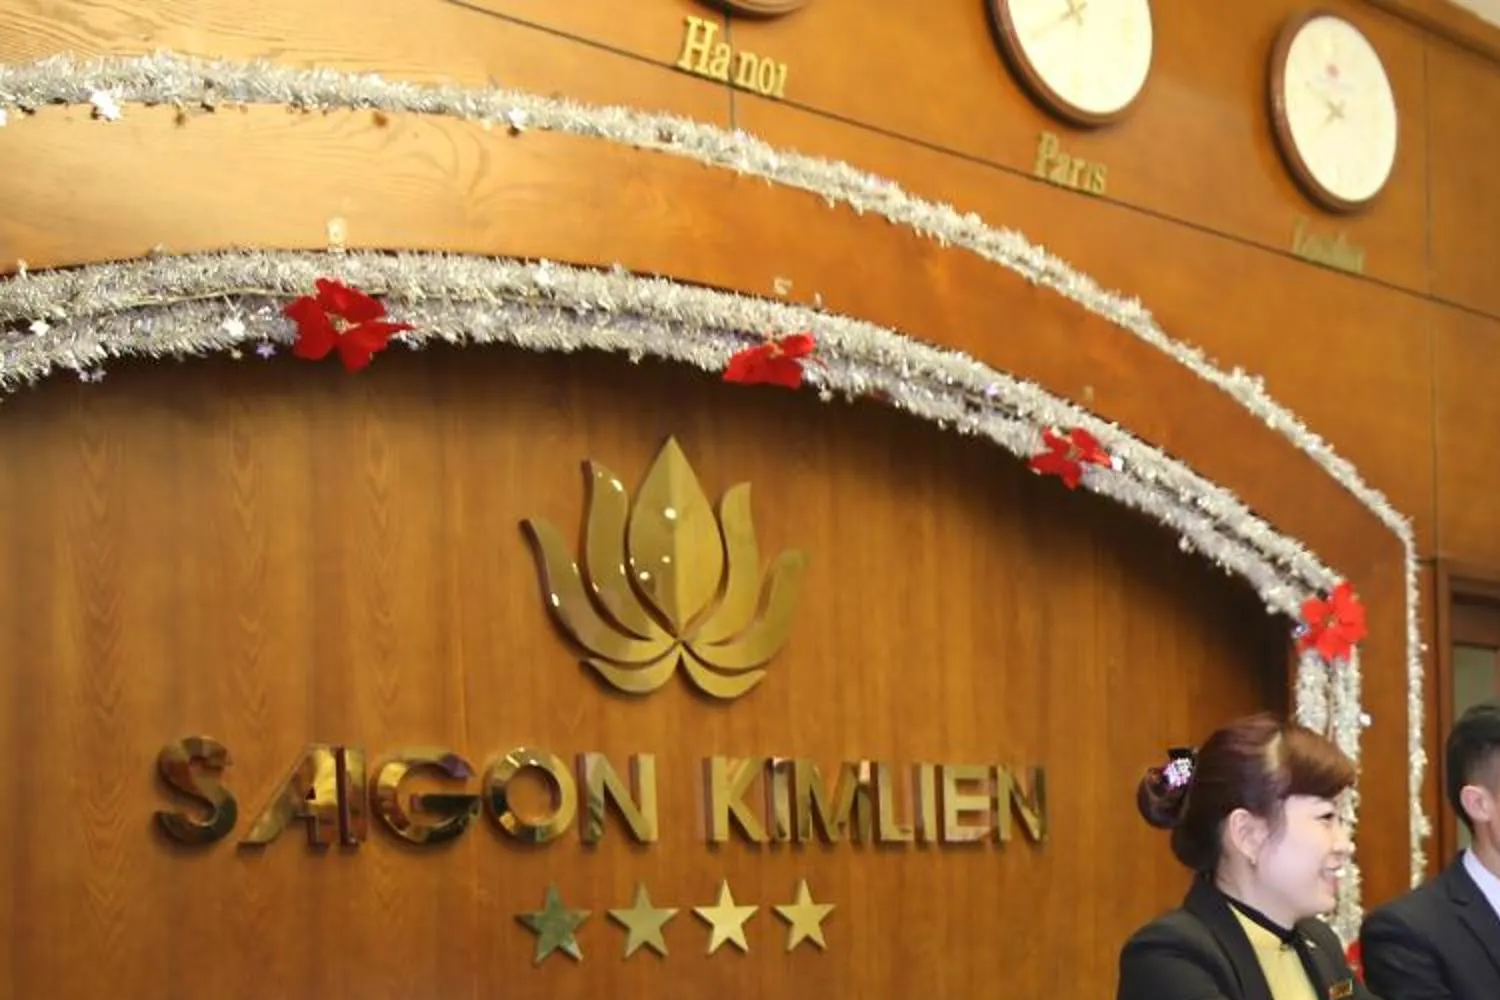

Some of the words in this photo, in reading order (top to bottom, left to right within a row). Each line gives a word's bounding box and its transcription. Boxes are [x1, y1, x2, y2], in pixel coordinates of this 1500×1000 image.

[677, 15, 788, 98] Hanoi
[1034, 131, 1107, 195] Paris
[154, 735, 658, 848] SAIGON
